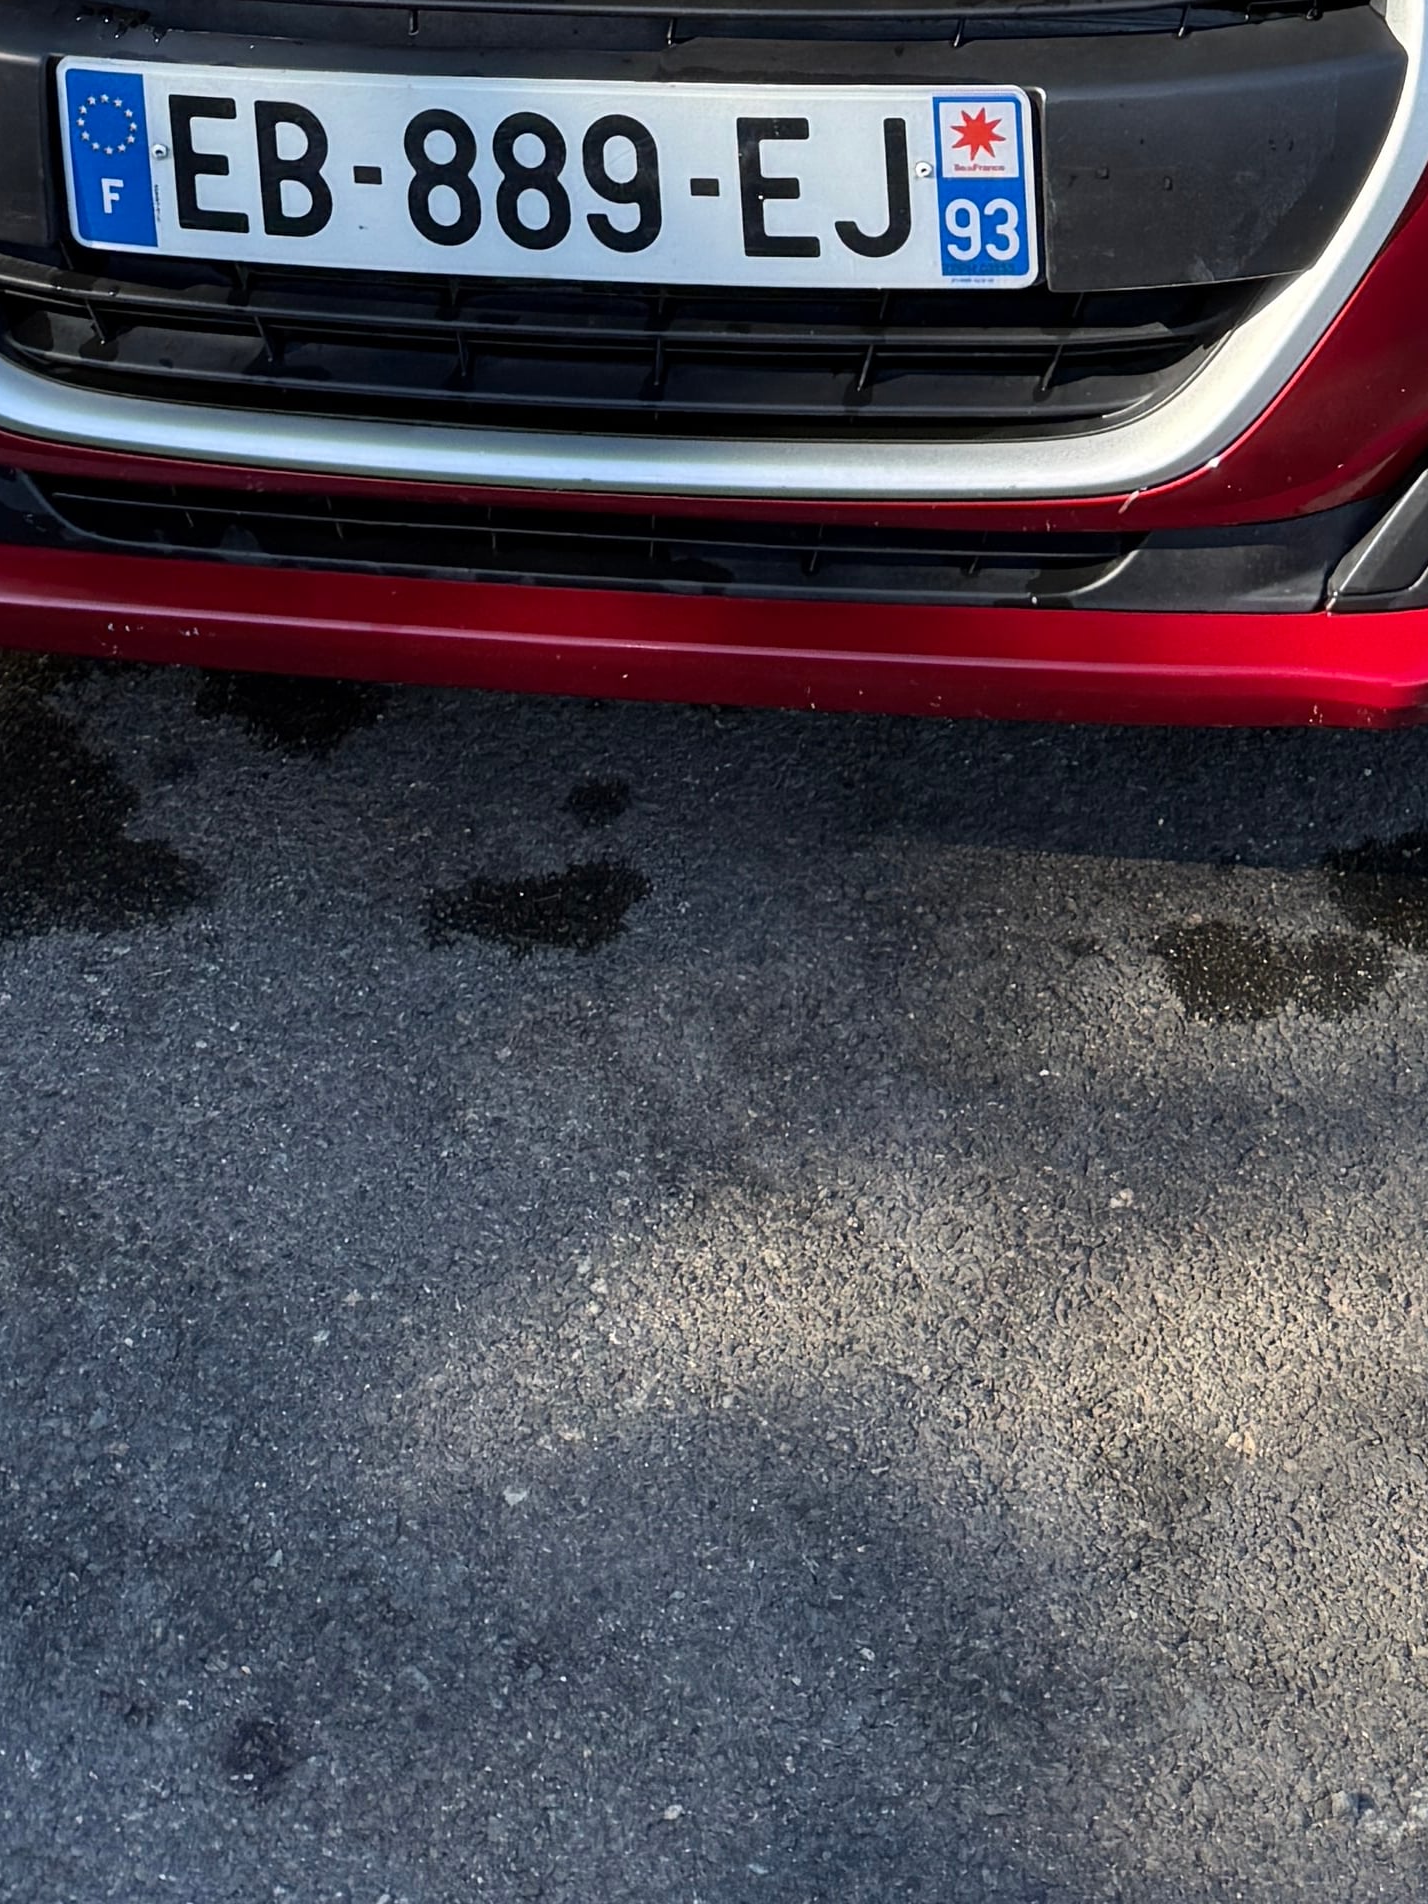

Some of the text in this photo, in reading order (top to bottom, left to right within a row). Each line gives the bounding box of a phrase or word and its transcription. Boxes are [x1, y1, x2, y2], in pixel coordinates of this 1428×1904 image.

[101, 177, 124, 214] F
[169, 94, 912, 258] EB-889-EJ
[945, 198, 1020, 261] 93
